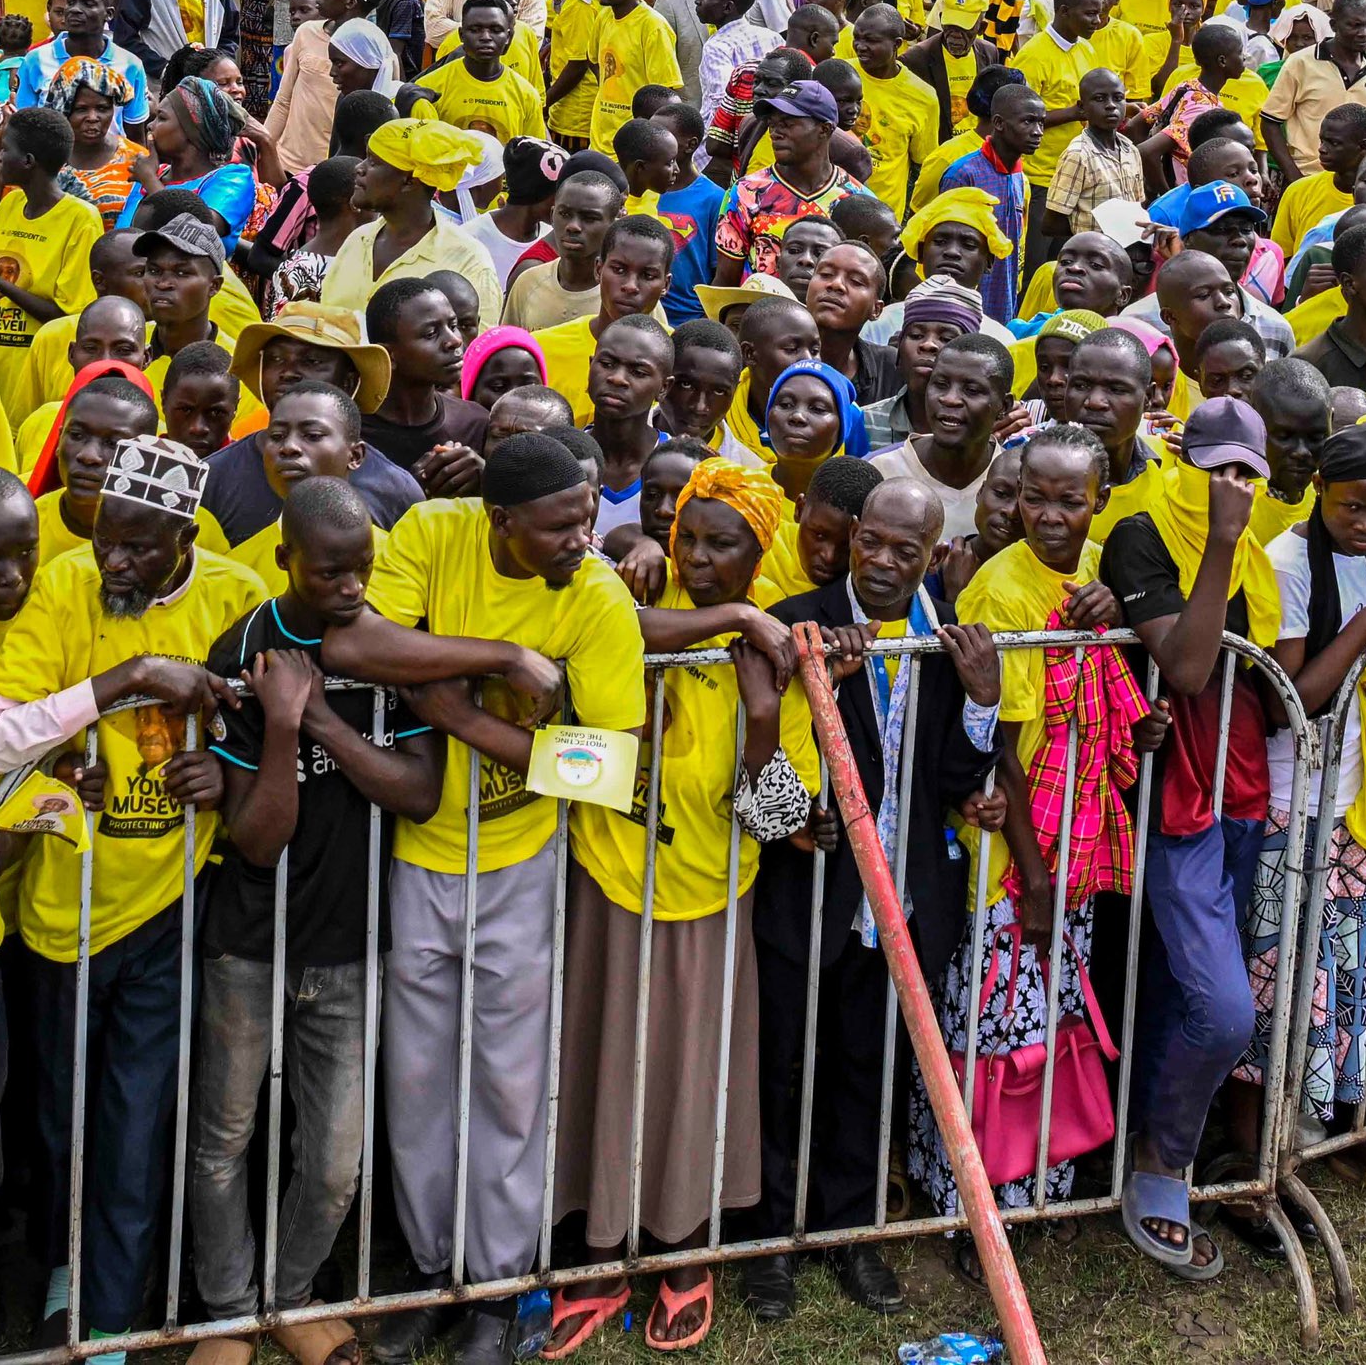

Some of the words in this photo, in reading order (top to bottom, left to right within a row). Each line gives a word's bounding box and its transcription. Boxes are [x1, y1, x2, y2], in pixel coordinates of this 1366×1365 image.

[475, 98, 504, 107] PRESIDENT
[795, 362, 823, 371] NIKE
[560, 731, 586, 739] GAINS
[555, 736, 607, 749] PROTECTING
[109, 818, 166, 831] PROTECTING
